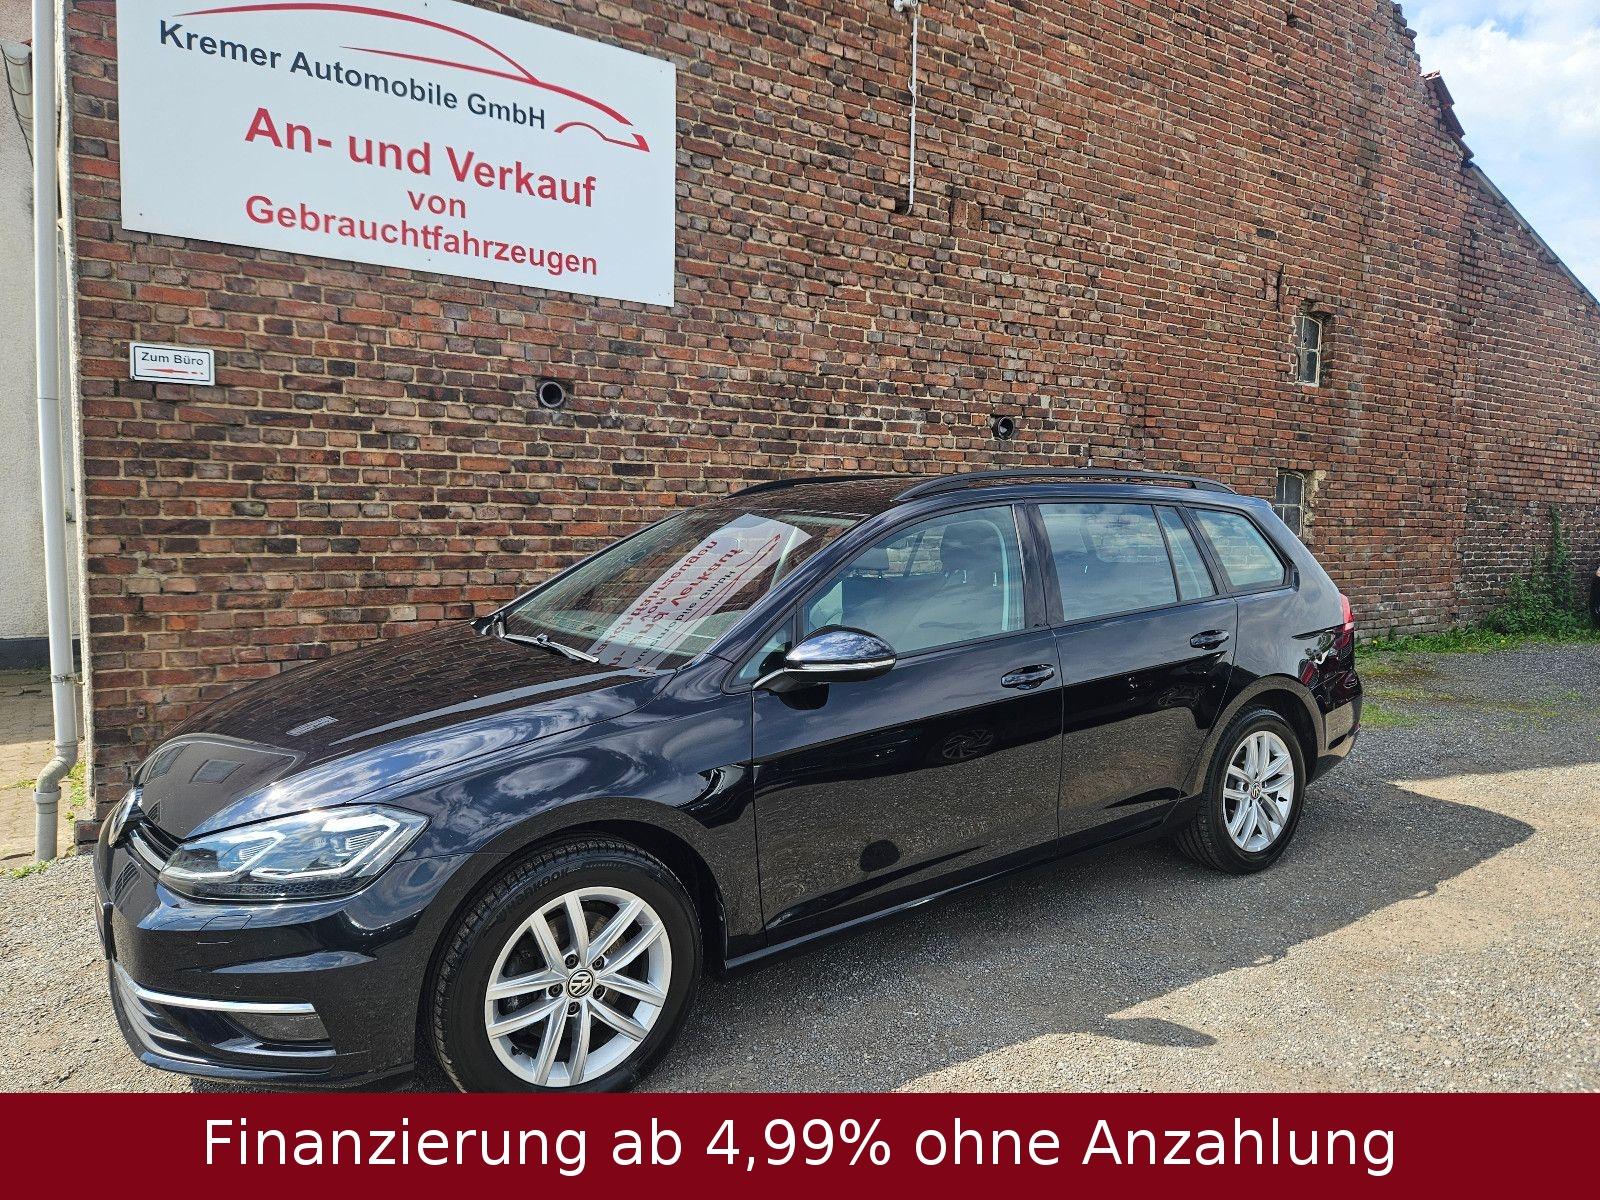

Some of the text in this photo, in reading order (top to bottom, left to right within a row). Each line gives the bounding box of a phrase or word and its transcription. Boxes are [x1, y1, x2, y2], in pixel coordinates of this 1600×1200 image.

[160, 19, 546, 130] Kremer Automobile GmbH
[245, 107, 596, 207] An- und Verkauf
[246, 195, 598, 276] Gebrauchtfahrzeugen
[407, 191, 466, 218] von
[141, 351, 204, 366] Zum Büro
